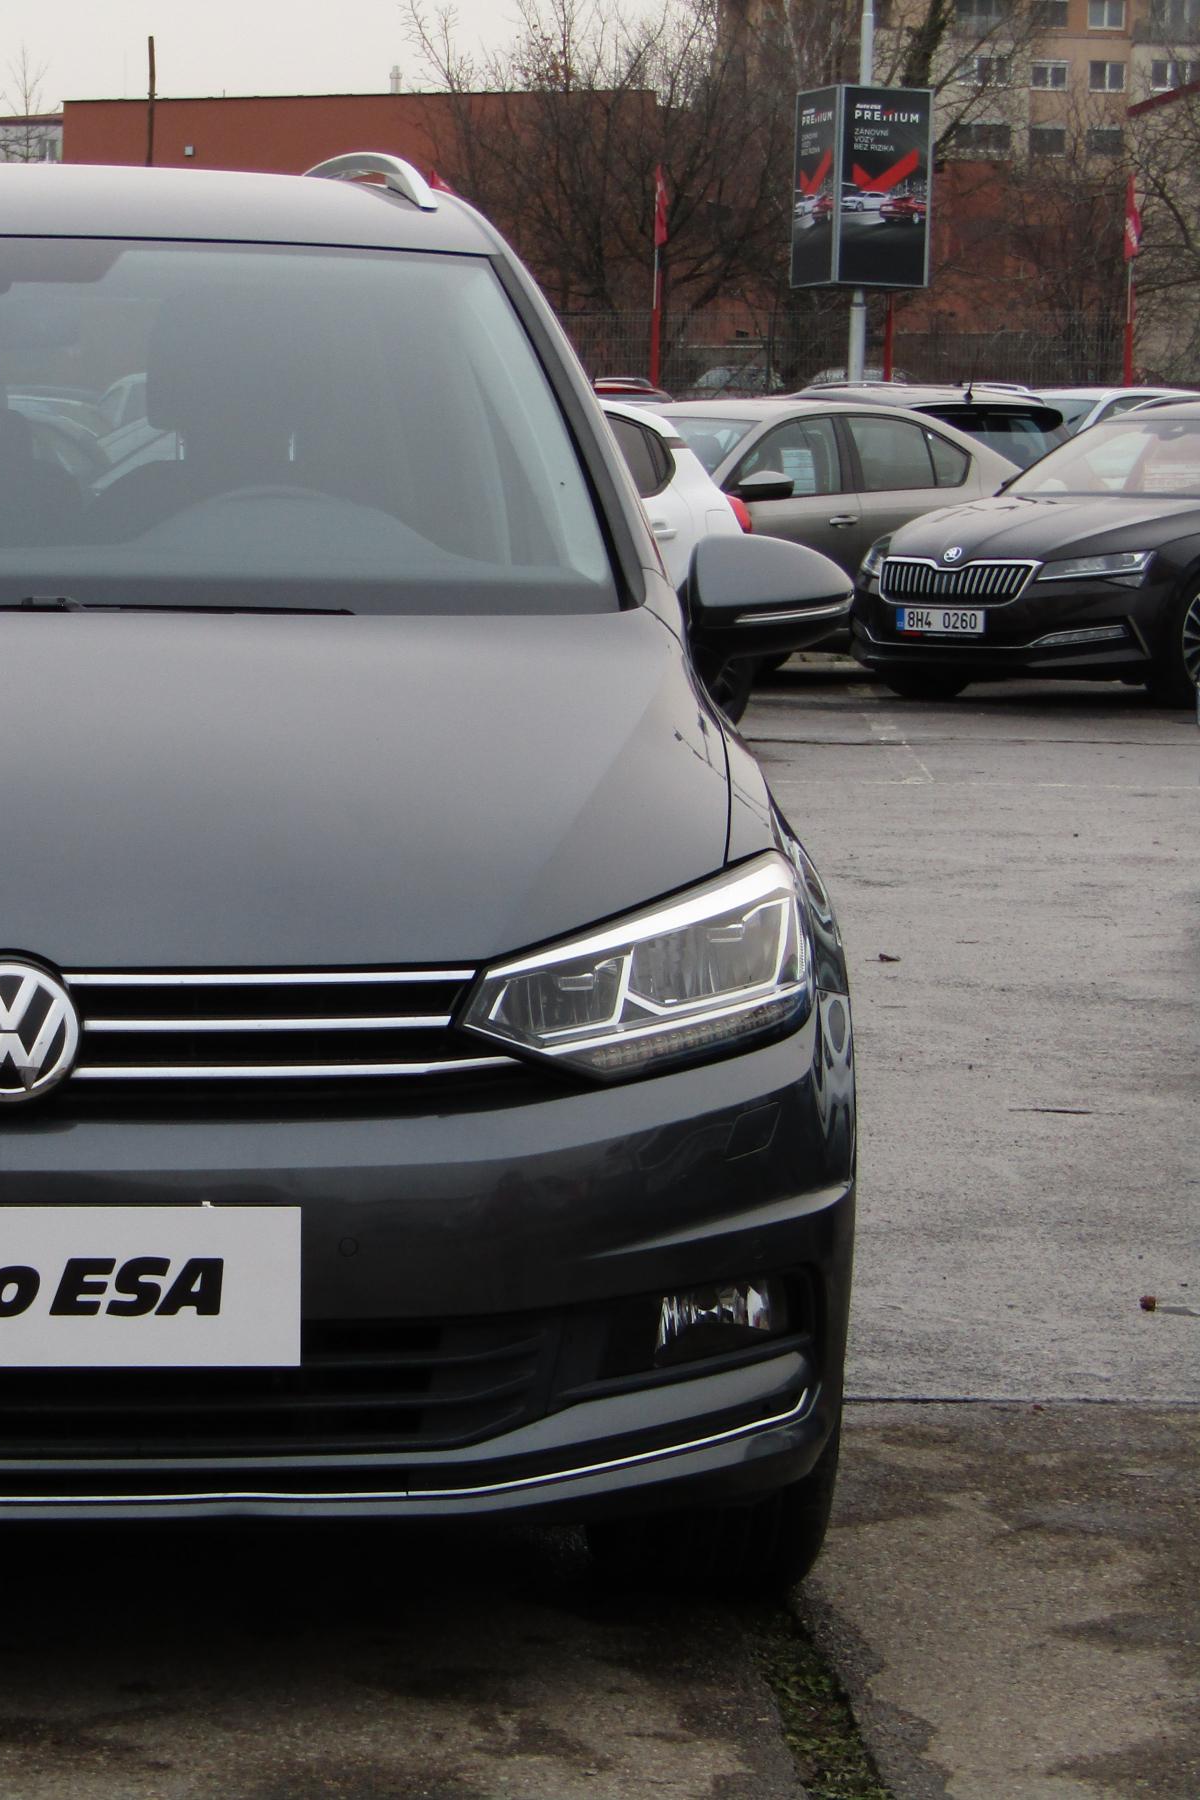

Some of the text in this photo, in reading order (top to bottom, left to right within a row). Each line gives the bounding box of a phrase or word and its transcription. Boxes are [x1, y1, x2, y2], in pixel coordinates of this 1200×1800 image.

[854, 110, 919, 124] PREMIUM
[907, 611, 977, 630] 8H4 0260
[49, 1257, 224, 1318] ESA
